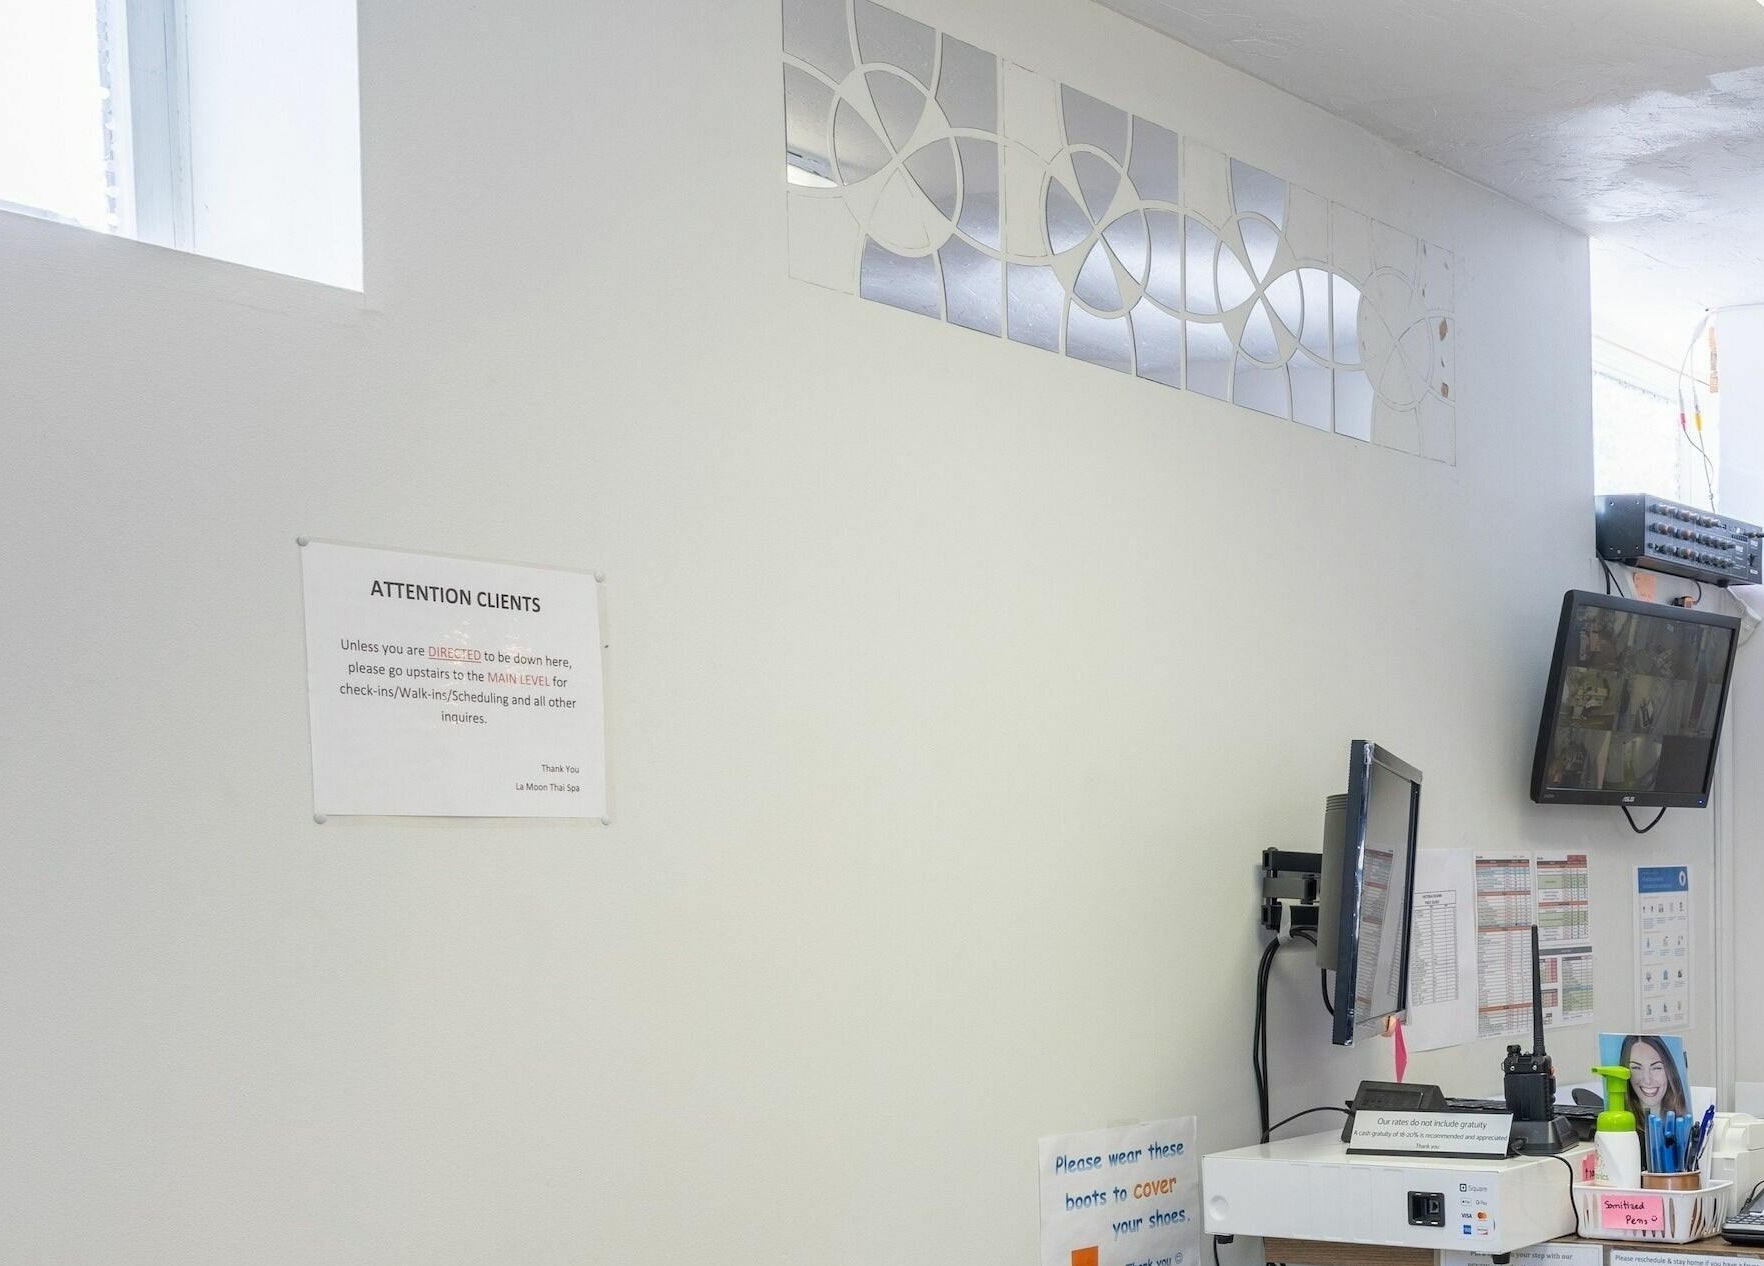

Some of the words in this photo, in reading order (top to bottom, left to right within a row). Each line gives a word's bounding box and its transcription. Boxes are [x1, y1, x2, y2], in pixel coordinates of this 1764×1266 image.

[370, 580, 471, 606] ATTENTION
[477, 591, 541, 613] CLIENTS
[340, 638, 380, 653] Unless
[382, 644, 404, 656] you
[406, 646, 425, 656] are
[428, 645, 482, 661] DIRECTED
[484, 651, 495, 662] to
[498, 651, 511, 663] be
[513, 652, 543, 666] down
[545, 655, 573, 670] here,
[348, 661, 386, 676] please
[388, 666, 403, 678] go
[406, 667, 450, 681] upstairs
[453, 669, 464, 681] to
[467, 670, 485, 682] the
[487, 672, 517, 685] MAIN
[520, 674, 551, 687] LEVEL
[552, 676, 568, 688] for
[339, 682, 509, 707] check-ins/Walk-ins/Scheduling
[511, 695, 531, 706] and
[533, 696, 546, 707] all
[548, 697, 577, 709] other
[441, 711, 488, 725] inquires.
[541, 764, 564, 773] Thank
[565, 765, 580, 774] You
[515, 782, 524, 791] La
[526, 782, 548, 791] Moon
[550, 783, 566, 792] Thai
[567, 783, 580, 794] Spa
[1377, 1117, 1391, 1125] Our
[1392, 1118, 1409, 1126] rates
[1410, 1117, 1420, 1127] do
[1421, 1119, 1433, 1127] not
[1433, 1118, 1460, 1128] include
[1460, 1120, 1488, 1130] gratuity
[1425, 1132, 1464, 1140] recommended
[1476, 1134, 1508, 1142] appreciated
[1055, 1155, 1102, 1175] Please
[1108, 1149, 1143, 1167] wear
[1148, 1141, 1185, 1161] these
[1066, 1189, 1107, 1211] boots
[1113, 1186, 1128, 1204] to
[1133, 1175, 1177, 1199] cover
[1112, 1216, 1143, 1241] your
[1149, 1208, 1191, 1230] shoes.
[1532, 1252, 1545, 1260] step
[1615, 1254, 1634, 1262] Please
[1634, 1255, 1666, 1264] reschedule
[1673, 1259, 1686, 1266] stay
